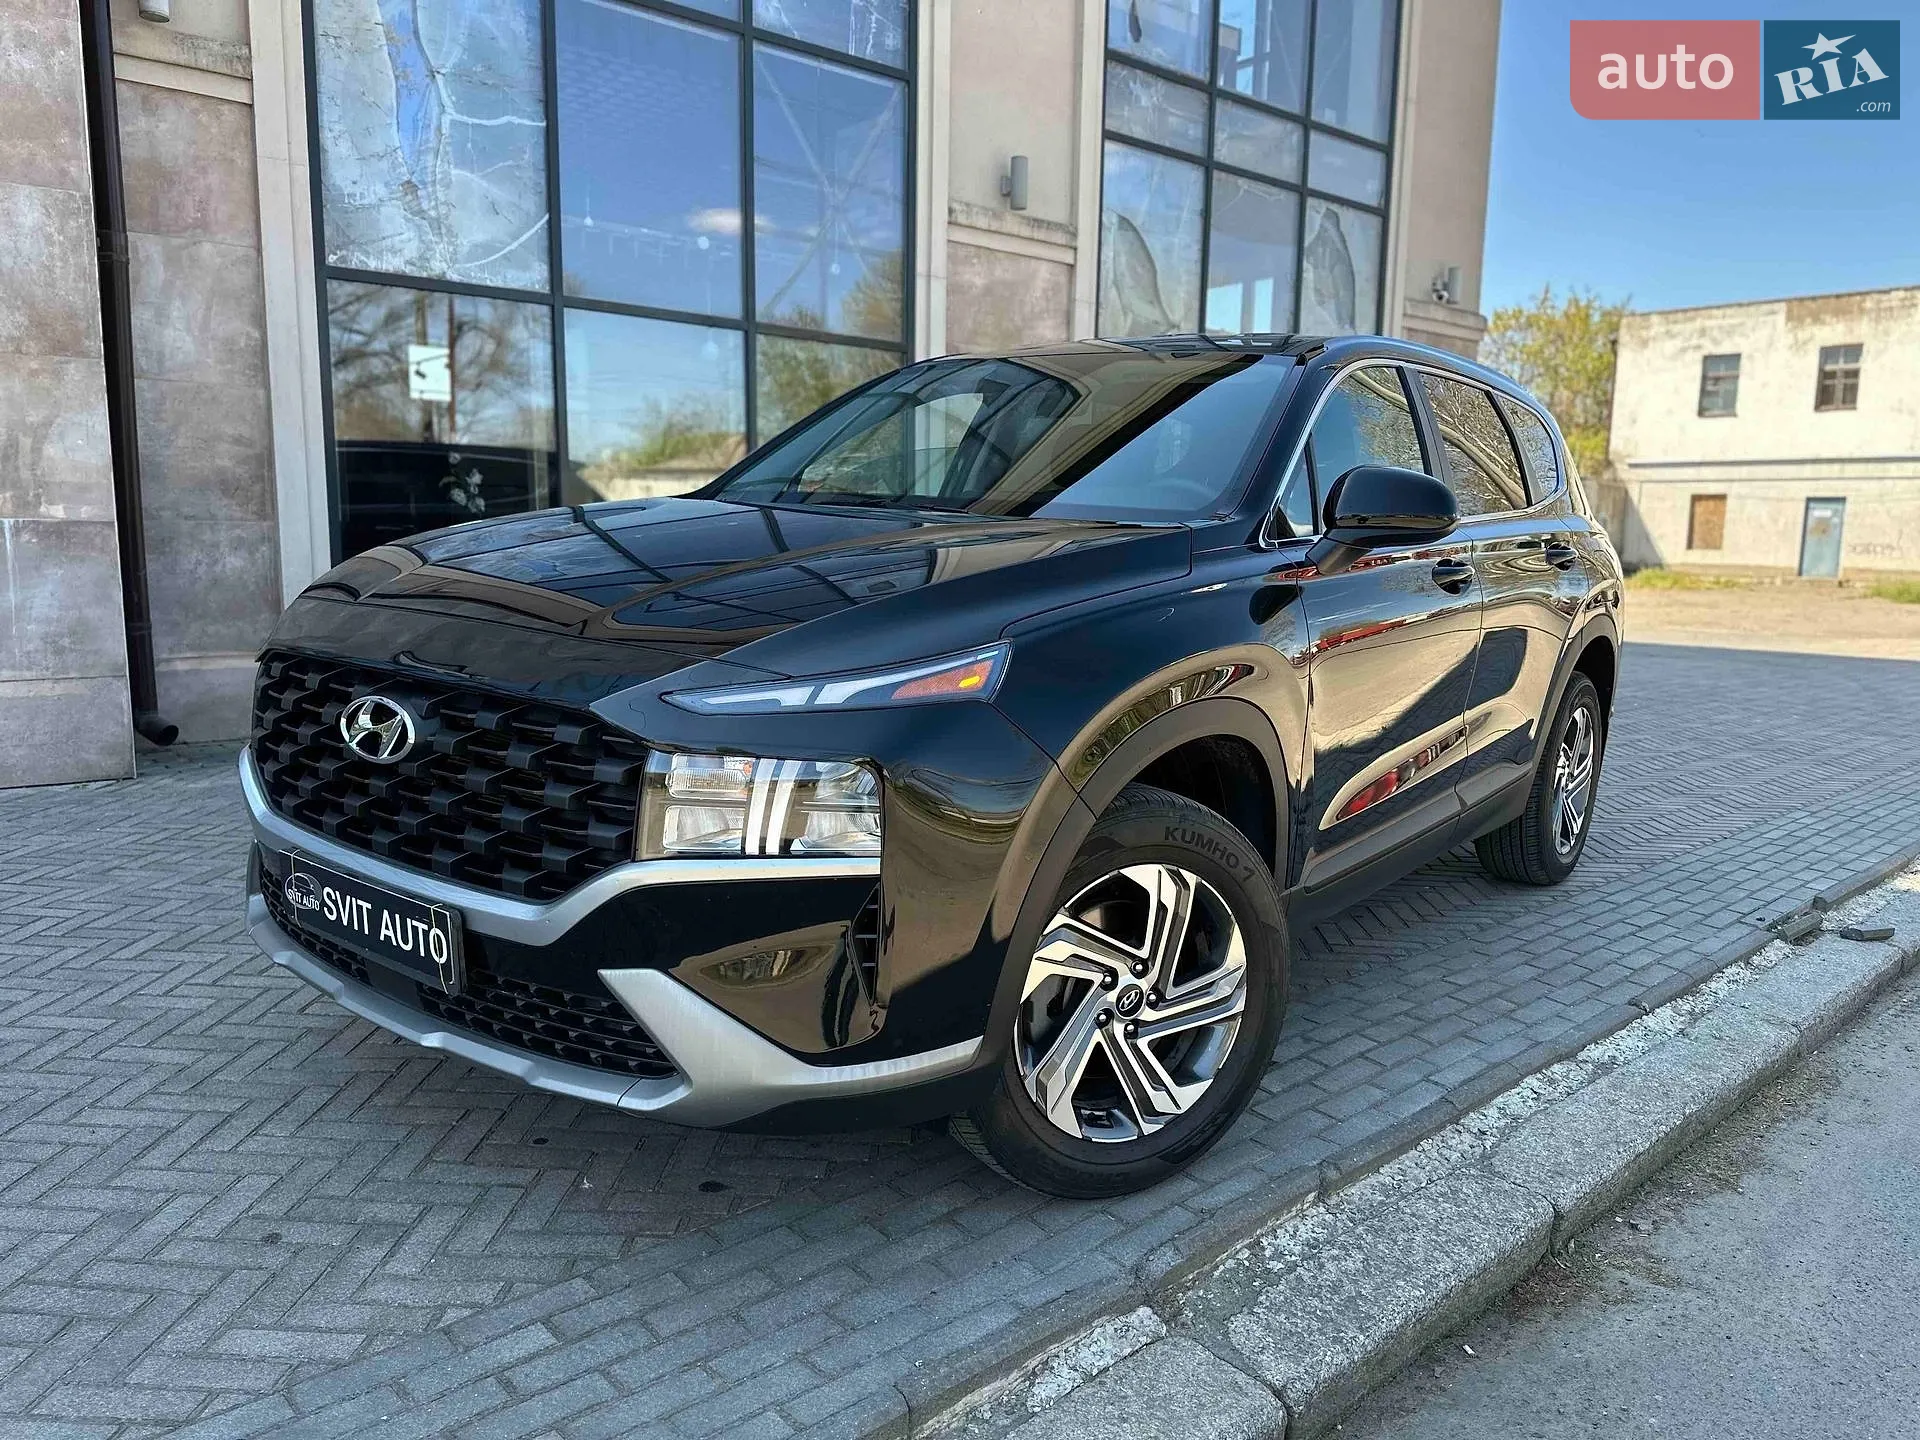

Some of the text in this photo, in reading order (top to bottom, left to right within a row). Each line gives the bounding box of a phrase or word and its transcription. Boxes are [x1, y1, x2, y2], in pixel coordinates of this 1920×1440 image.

[1164, 826, 1240, 869] KUMHO
[303, 895, 320, 910] AUTO
[323, 886, 448, 964] SVIT AUTO
